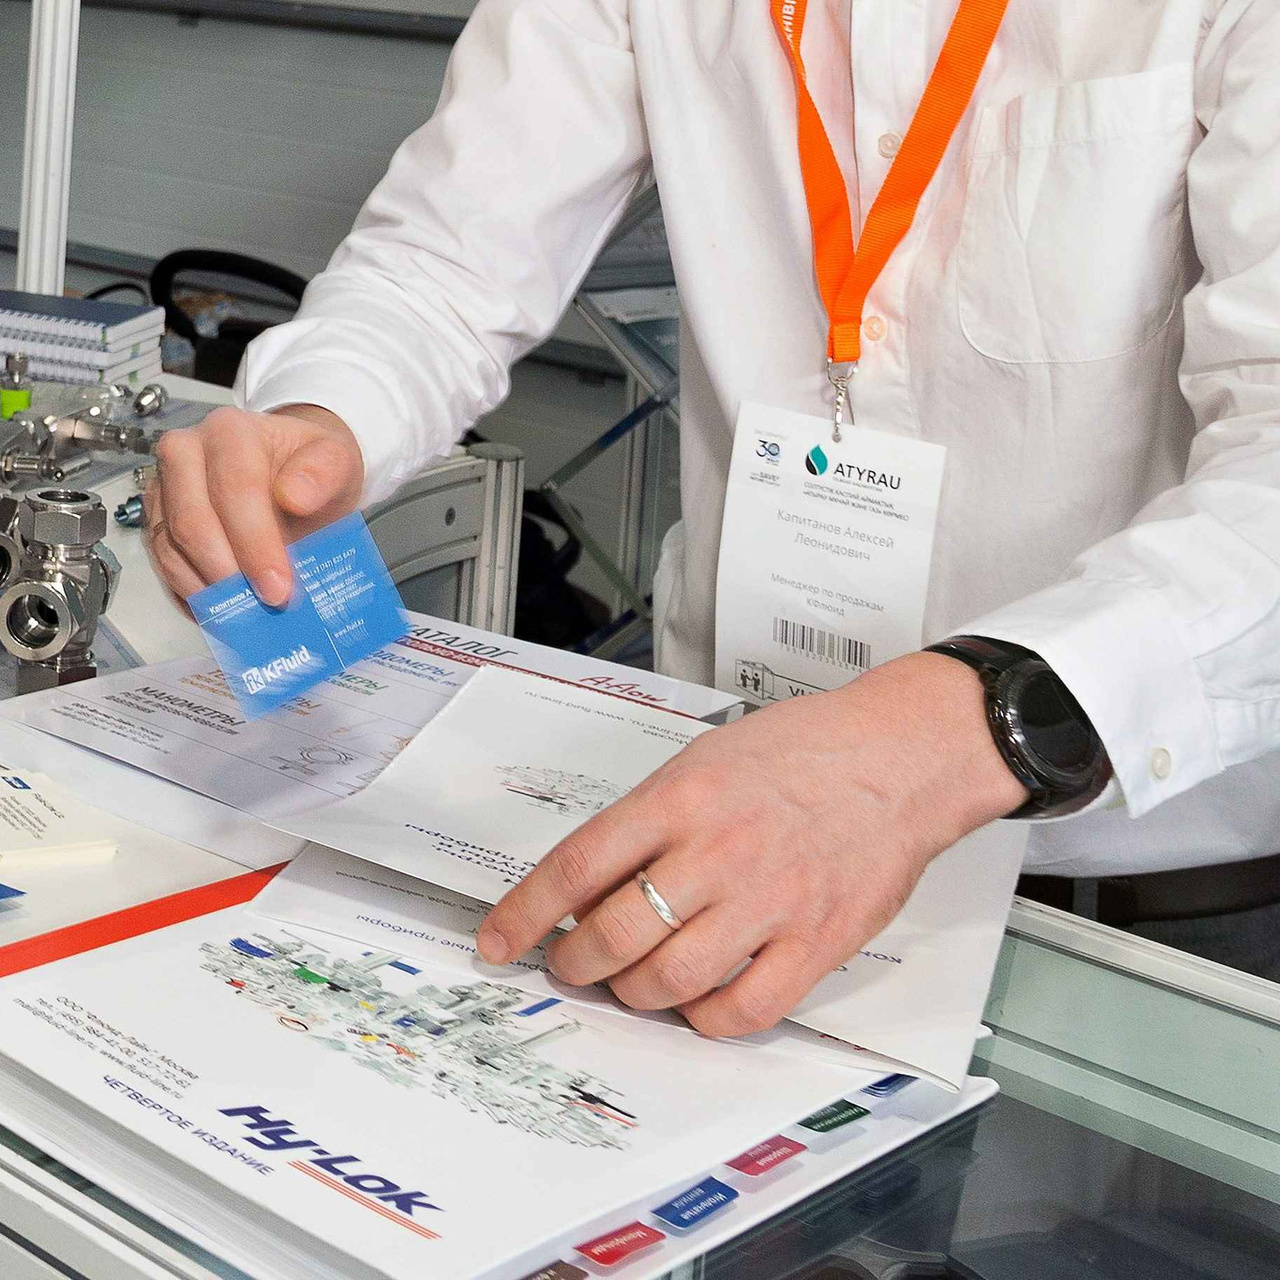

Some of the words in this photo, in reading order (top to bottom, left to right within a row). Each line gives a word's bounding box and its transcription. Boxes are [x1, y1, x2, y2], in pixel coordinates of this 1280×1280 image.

[833, 461, 901, 491] ATYRAU
[776, 508, 842, 535] Капитанов
[843, 525, 895, 550] Алексей
[793, 532, 871, 562] Леонидович
[208, 592, 246, 615] Капитанов
[769, 572, 821, 596] Менеджер
[820, 588, 834, 599] по
[833, 590, 885, 614] продажам
[262, 644, 312, 683] KFluid
[136, 686, 249, 728] МАНОМЕТРЫ
[405, 822, 516, 862] приборы
[355, 913, 438, 949] приборы
[56, 993, 83, 1014] ООО
[158, 1053, 199, 1083] Москва
[101, 1074, 192, 1132] ЧЕТВЕРТОЕ
[190, 1125, 277, 1177] ИЗДАНИЕ
[216, 1104, 447, 1218] Hy-Lok
[678, 1190, 728, 1222] Игольчатые
